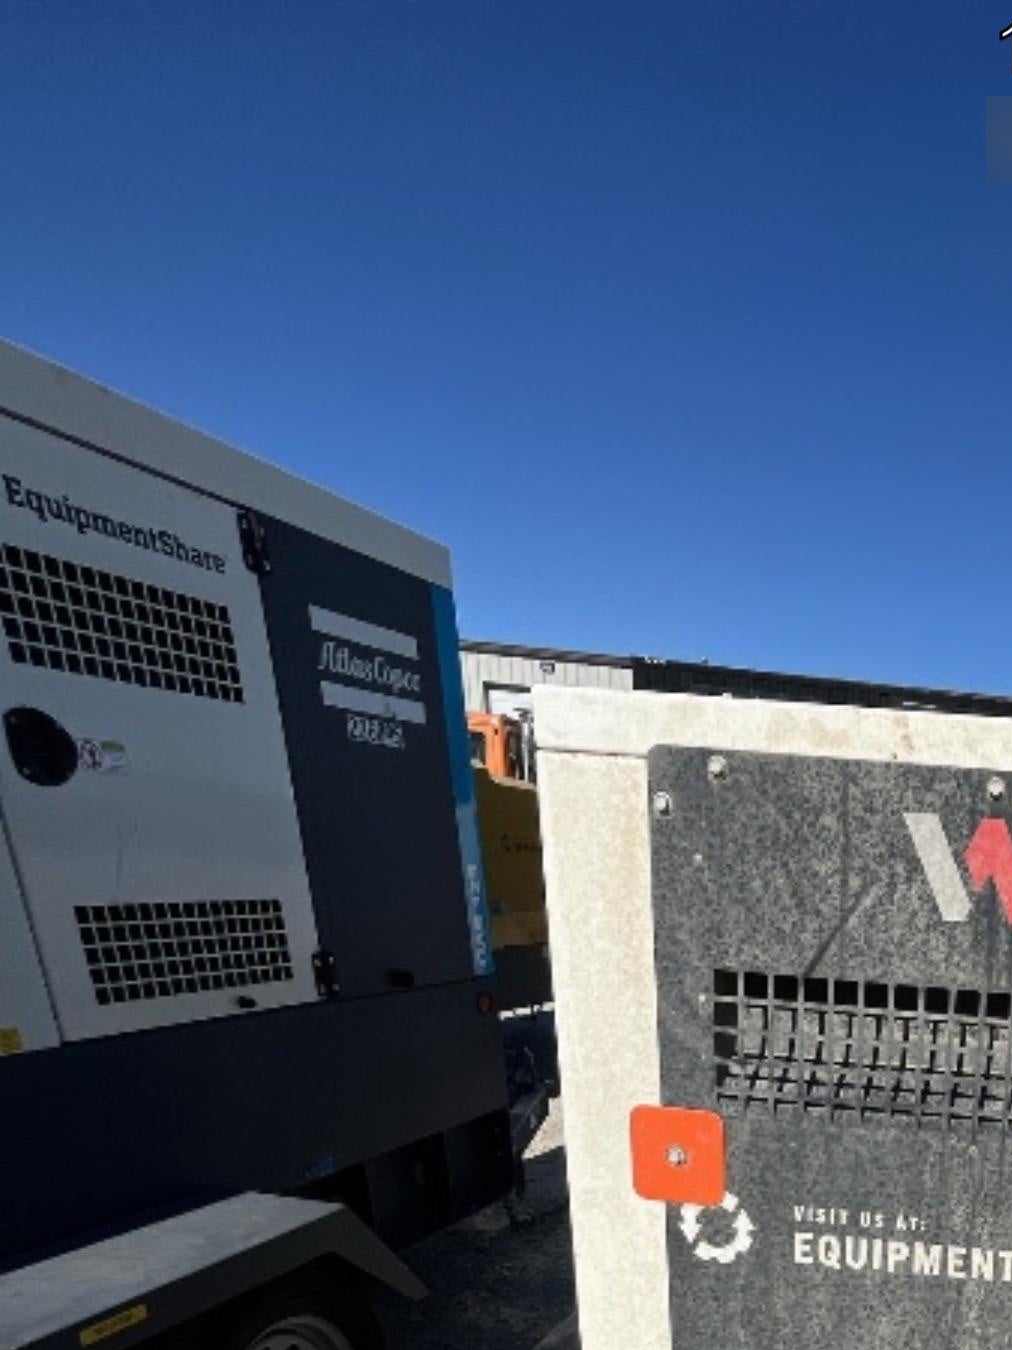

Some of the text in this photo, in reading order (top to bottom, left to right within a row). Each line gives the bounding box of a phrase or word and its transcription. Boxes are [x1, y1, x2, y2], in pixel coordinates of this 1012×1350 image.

[2, 473, 226, 574] EquipmentShare
[793, 1205, 926, 1232] VISIT US AT:
